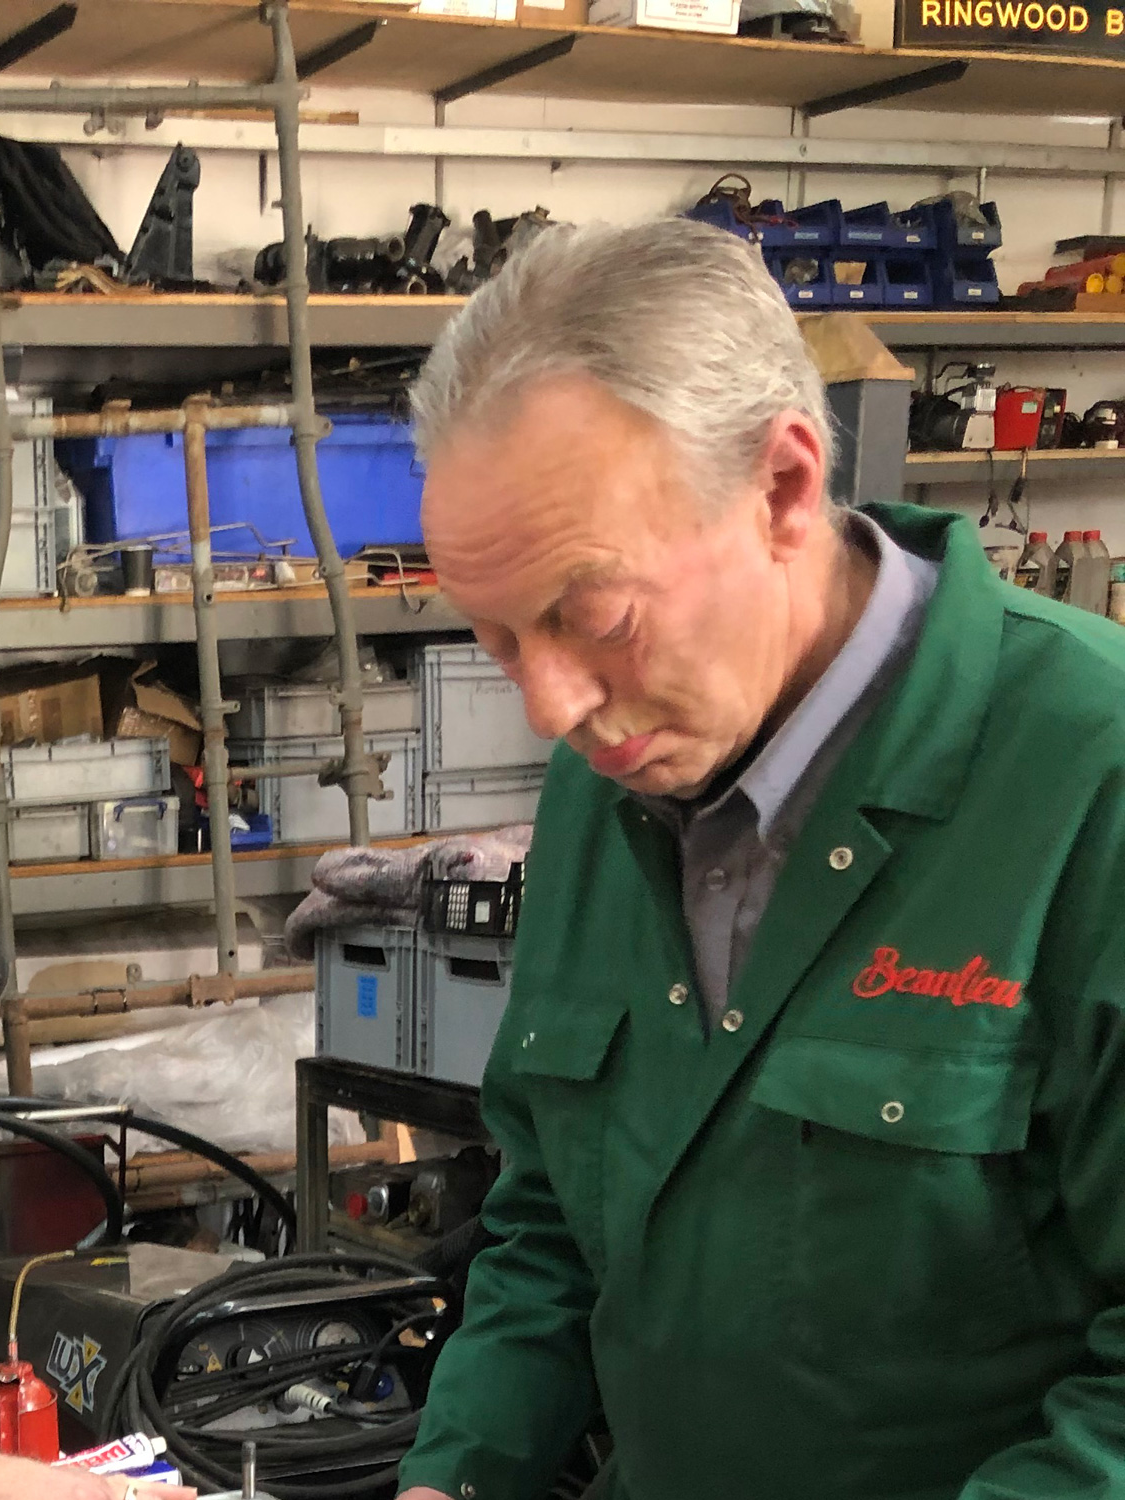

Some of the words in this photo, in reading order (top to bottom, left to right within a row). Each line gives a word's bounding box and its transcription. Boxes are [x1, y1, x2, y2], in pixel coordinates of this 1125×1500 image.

[921, 0, 1089, 33] RINGWOOD
[1106, 8, 1124, 36] B
[47, 1332, 106, 1412] LUX
